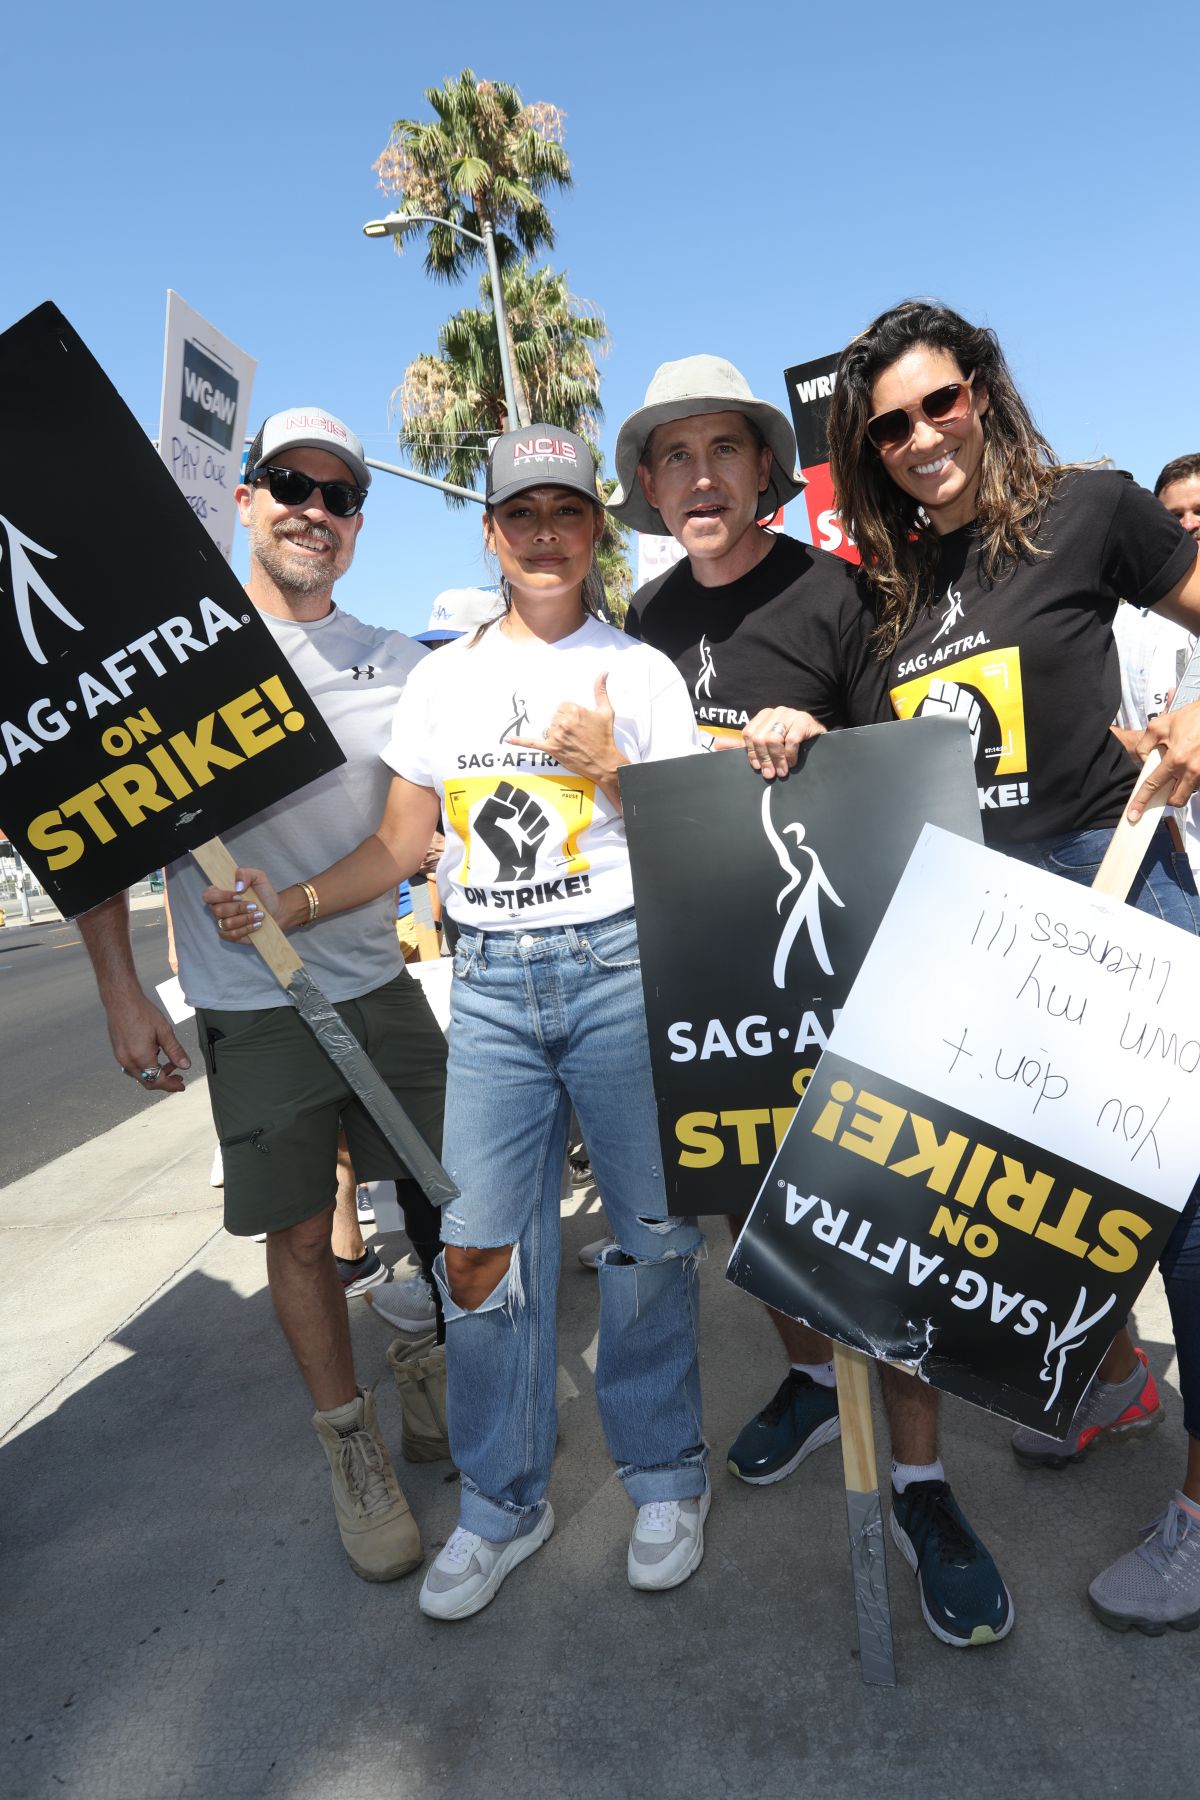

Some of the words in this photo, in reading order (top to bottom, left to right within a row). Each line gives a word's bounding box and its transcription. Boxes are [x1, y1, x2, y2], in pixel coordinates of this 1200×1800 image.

[184, 366, 237, 426] WGAW
[286, 415, 348, 443] NCIS
[513, 438, 577, 460] NCIS
[102, 707, 162, 756] ON
[28, 675, 304, 870] STRIKE!
[976, 781, 1030, 810] KE!
[464, 887, 488, 907] ON
[491, 874, 592, 910] STRIKE!
[1016, 954, 1087, 1025] my
[813, 1081, 1152, 1273] STRIKE!
[930, 1206, 998, 1258] ON
